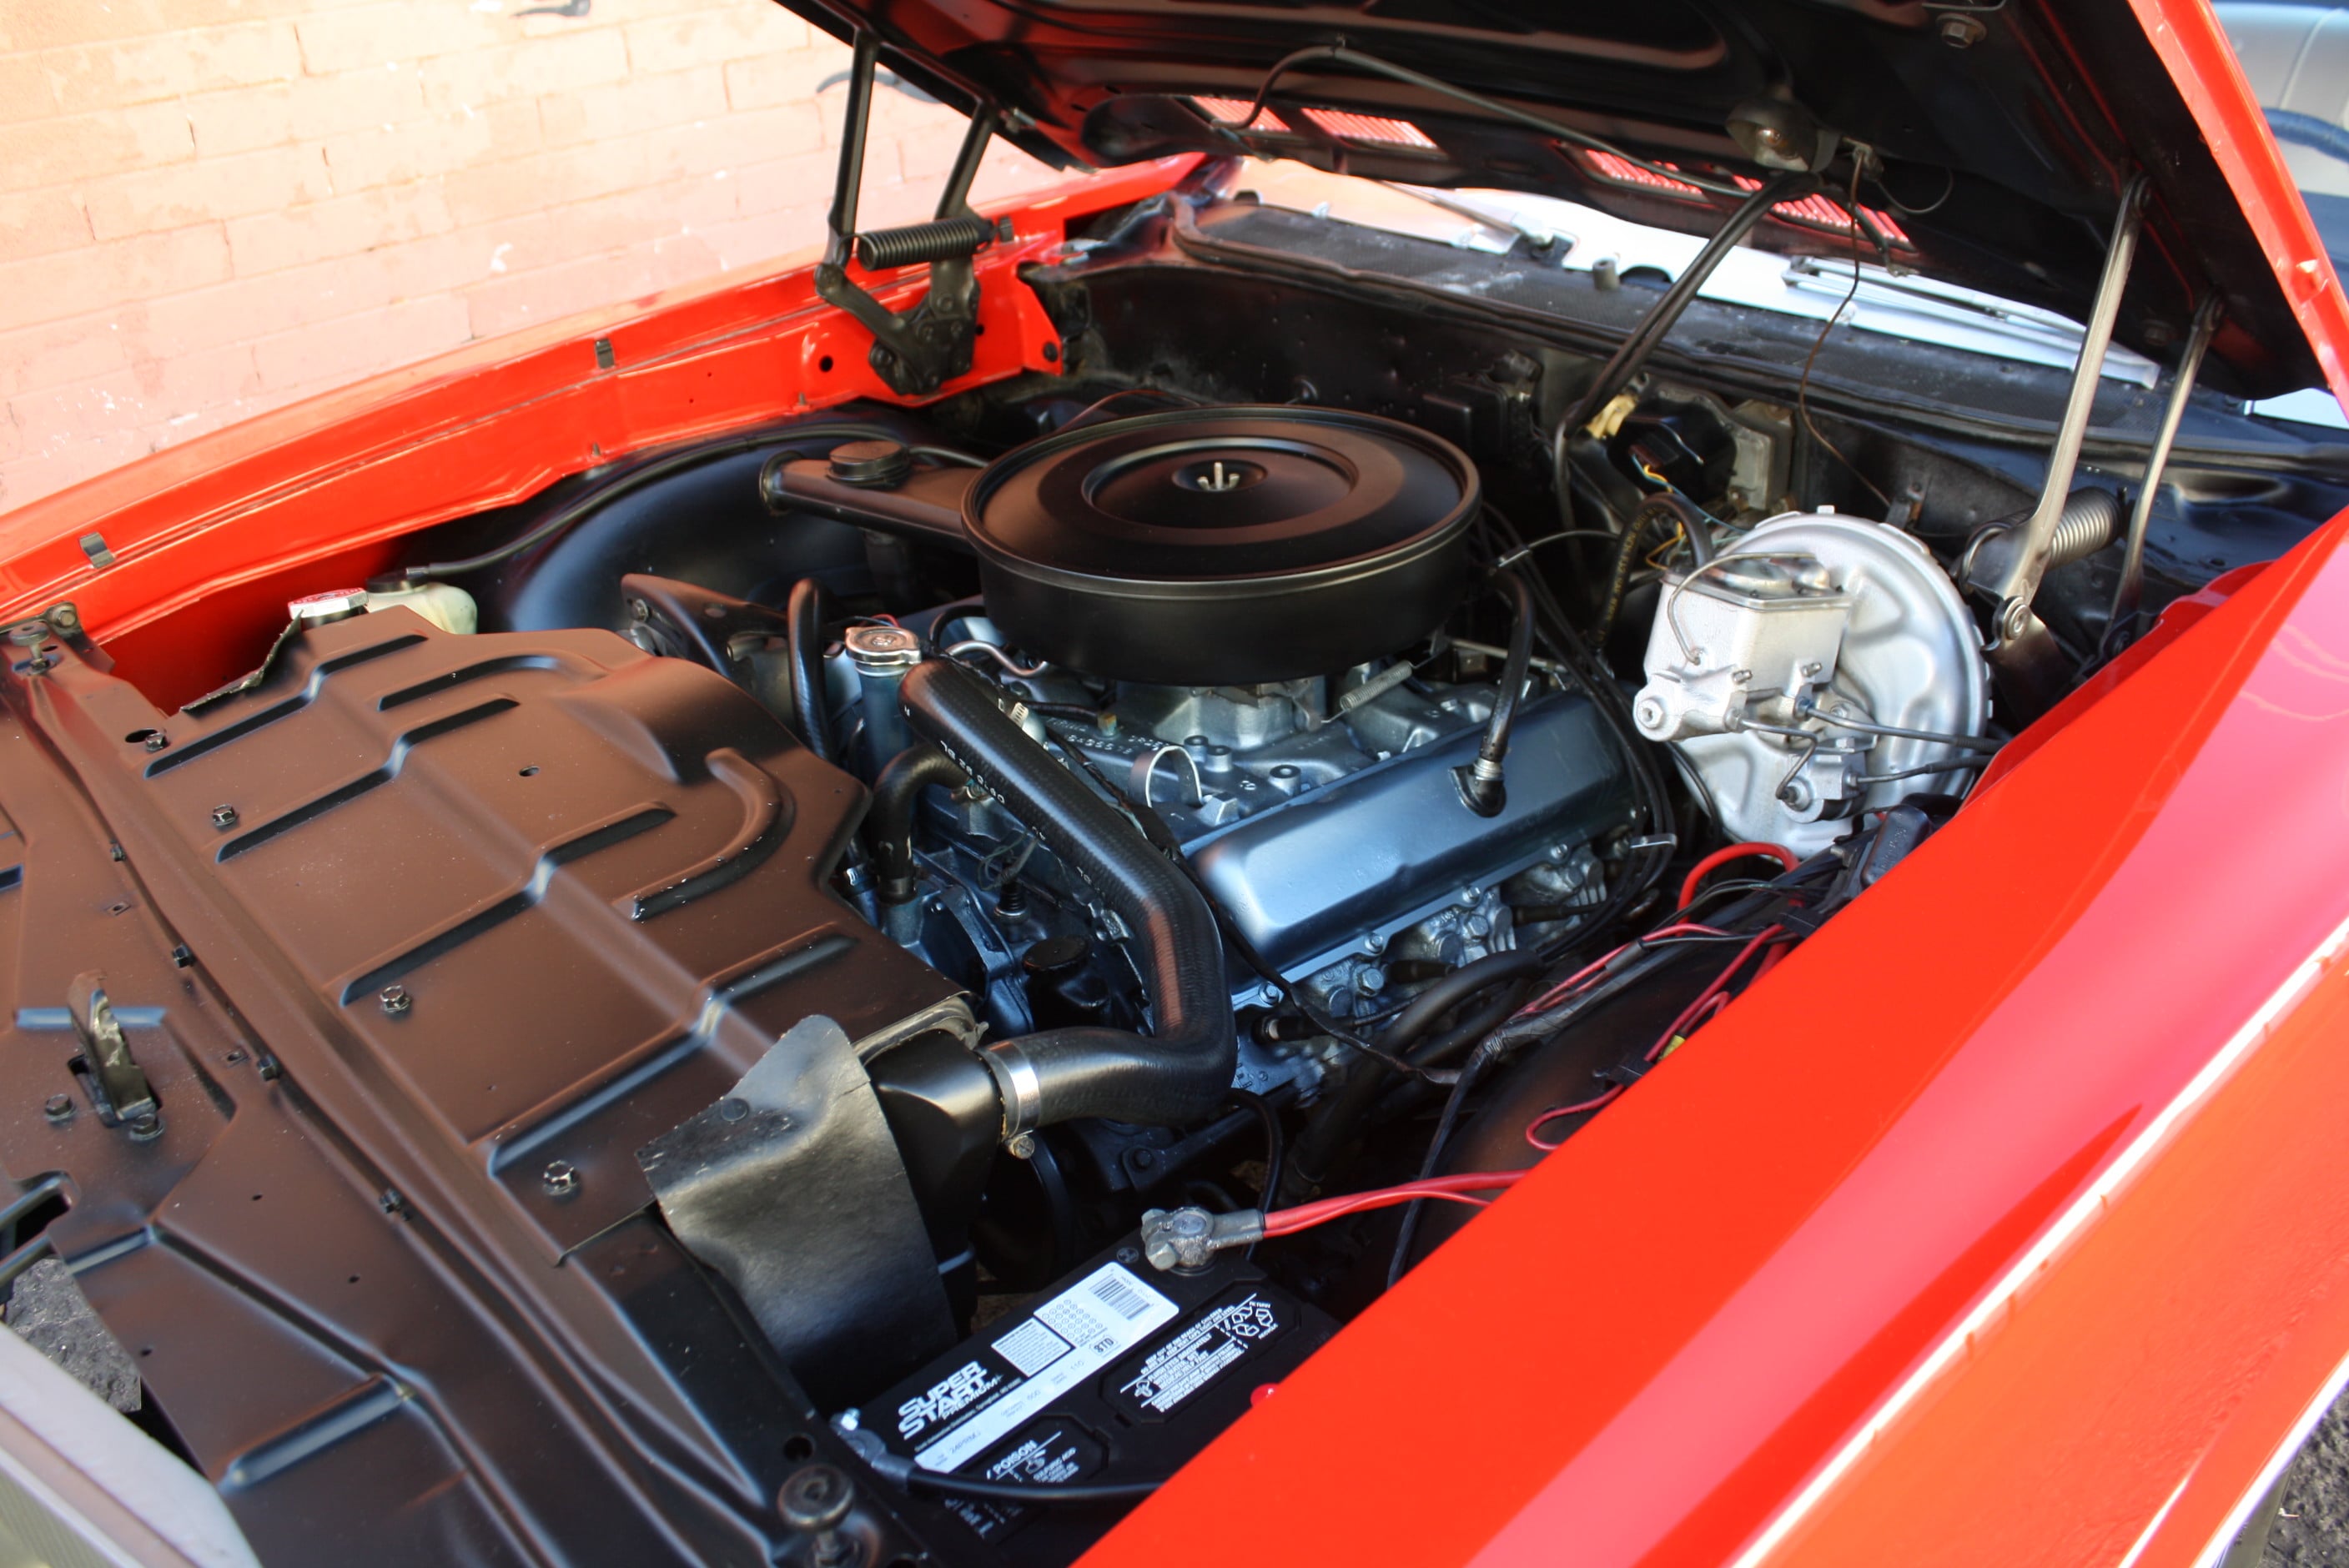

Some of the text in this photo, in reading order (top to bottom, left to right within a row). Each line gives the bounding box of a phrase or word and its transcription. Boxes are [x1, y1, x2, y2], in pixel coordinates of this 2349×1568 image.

[898, 1361, 982, 1422] SUPER
[898, 1369, 988, 1440] START
[993, 1440, 1038, 1475] POISON
